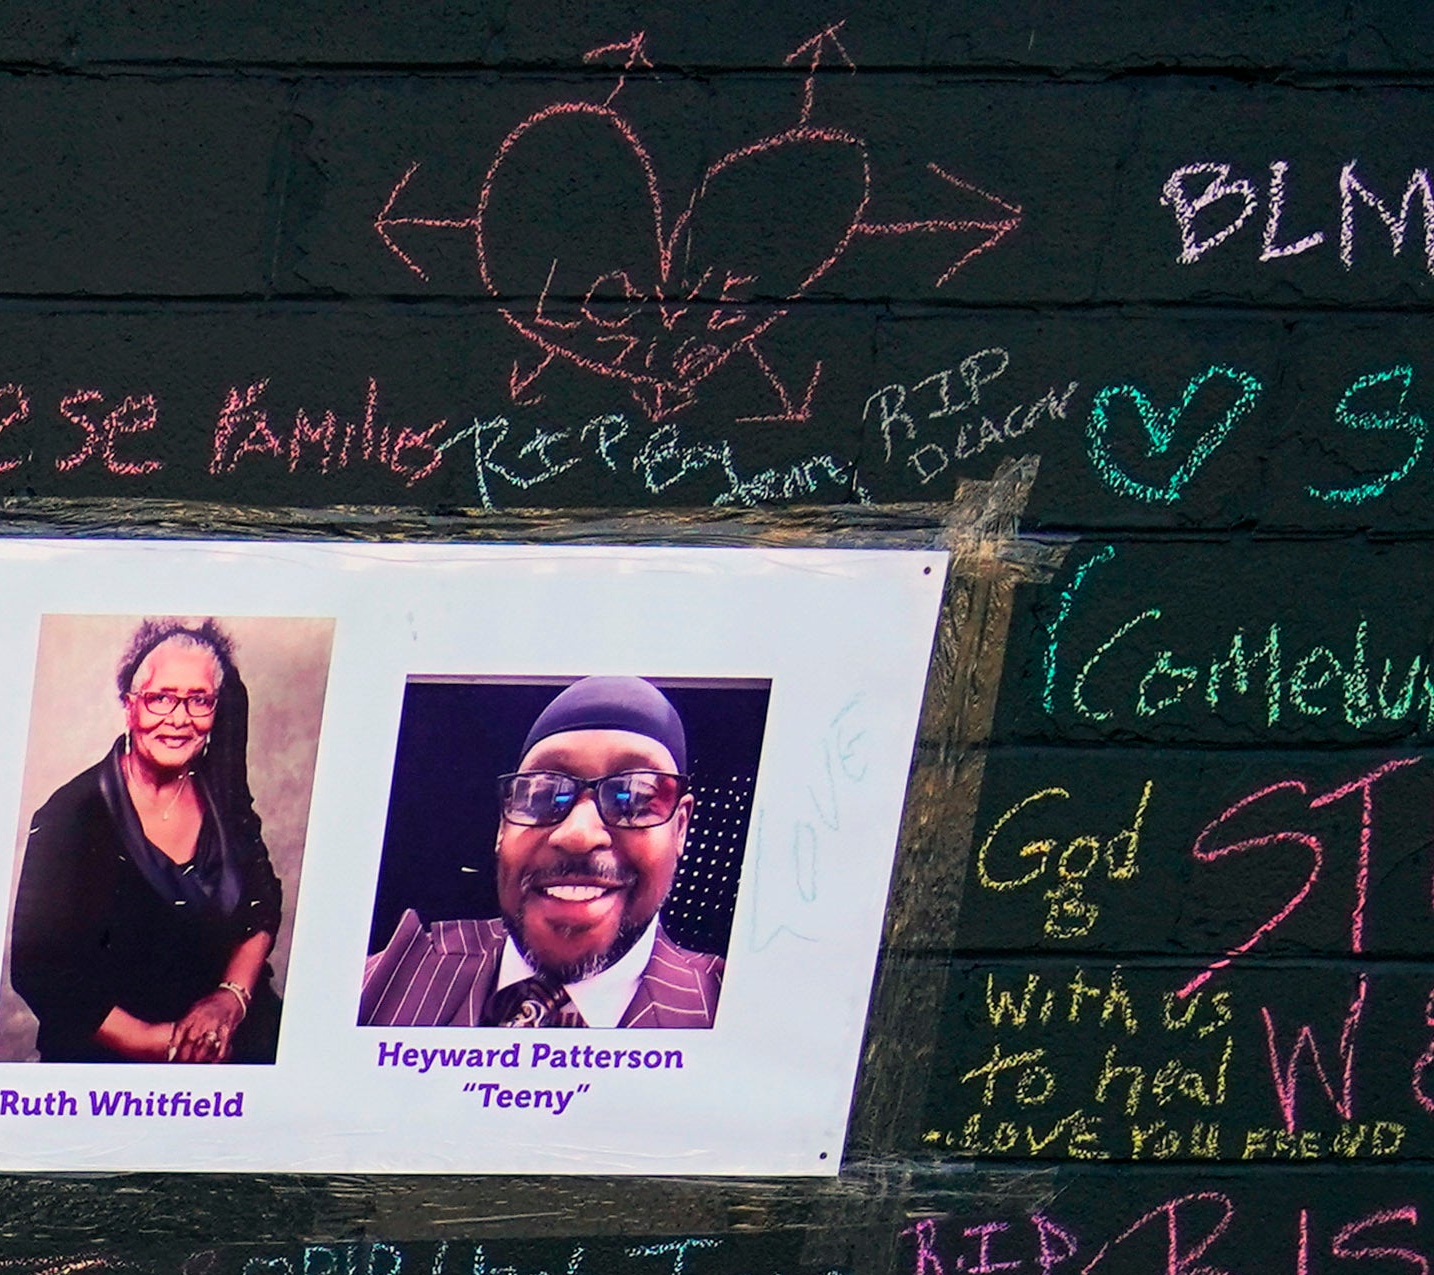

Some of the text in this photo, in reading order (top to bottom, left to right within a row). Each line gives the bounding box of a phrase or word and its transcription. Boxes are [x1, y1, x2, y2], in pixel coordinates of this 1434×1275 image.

[1159, 160, 1434, 275] BLM
[377, 1041, 684, 1074] Heyward Patterson
[0, 1089, 244, 1118] Ruth Whitfield
